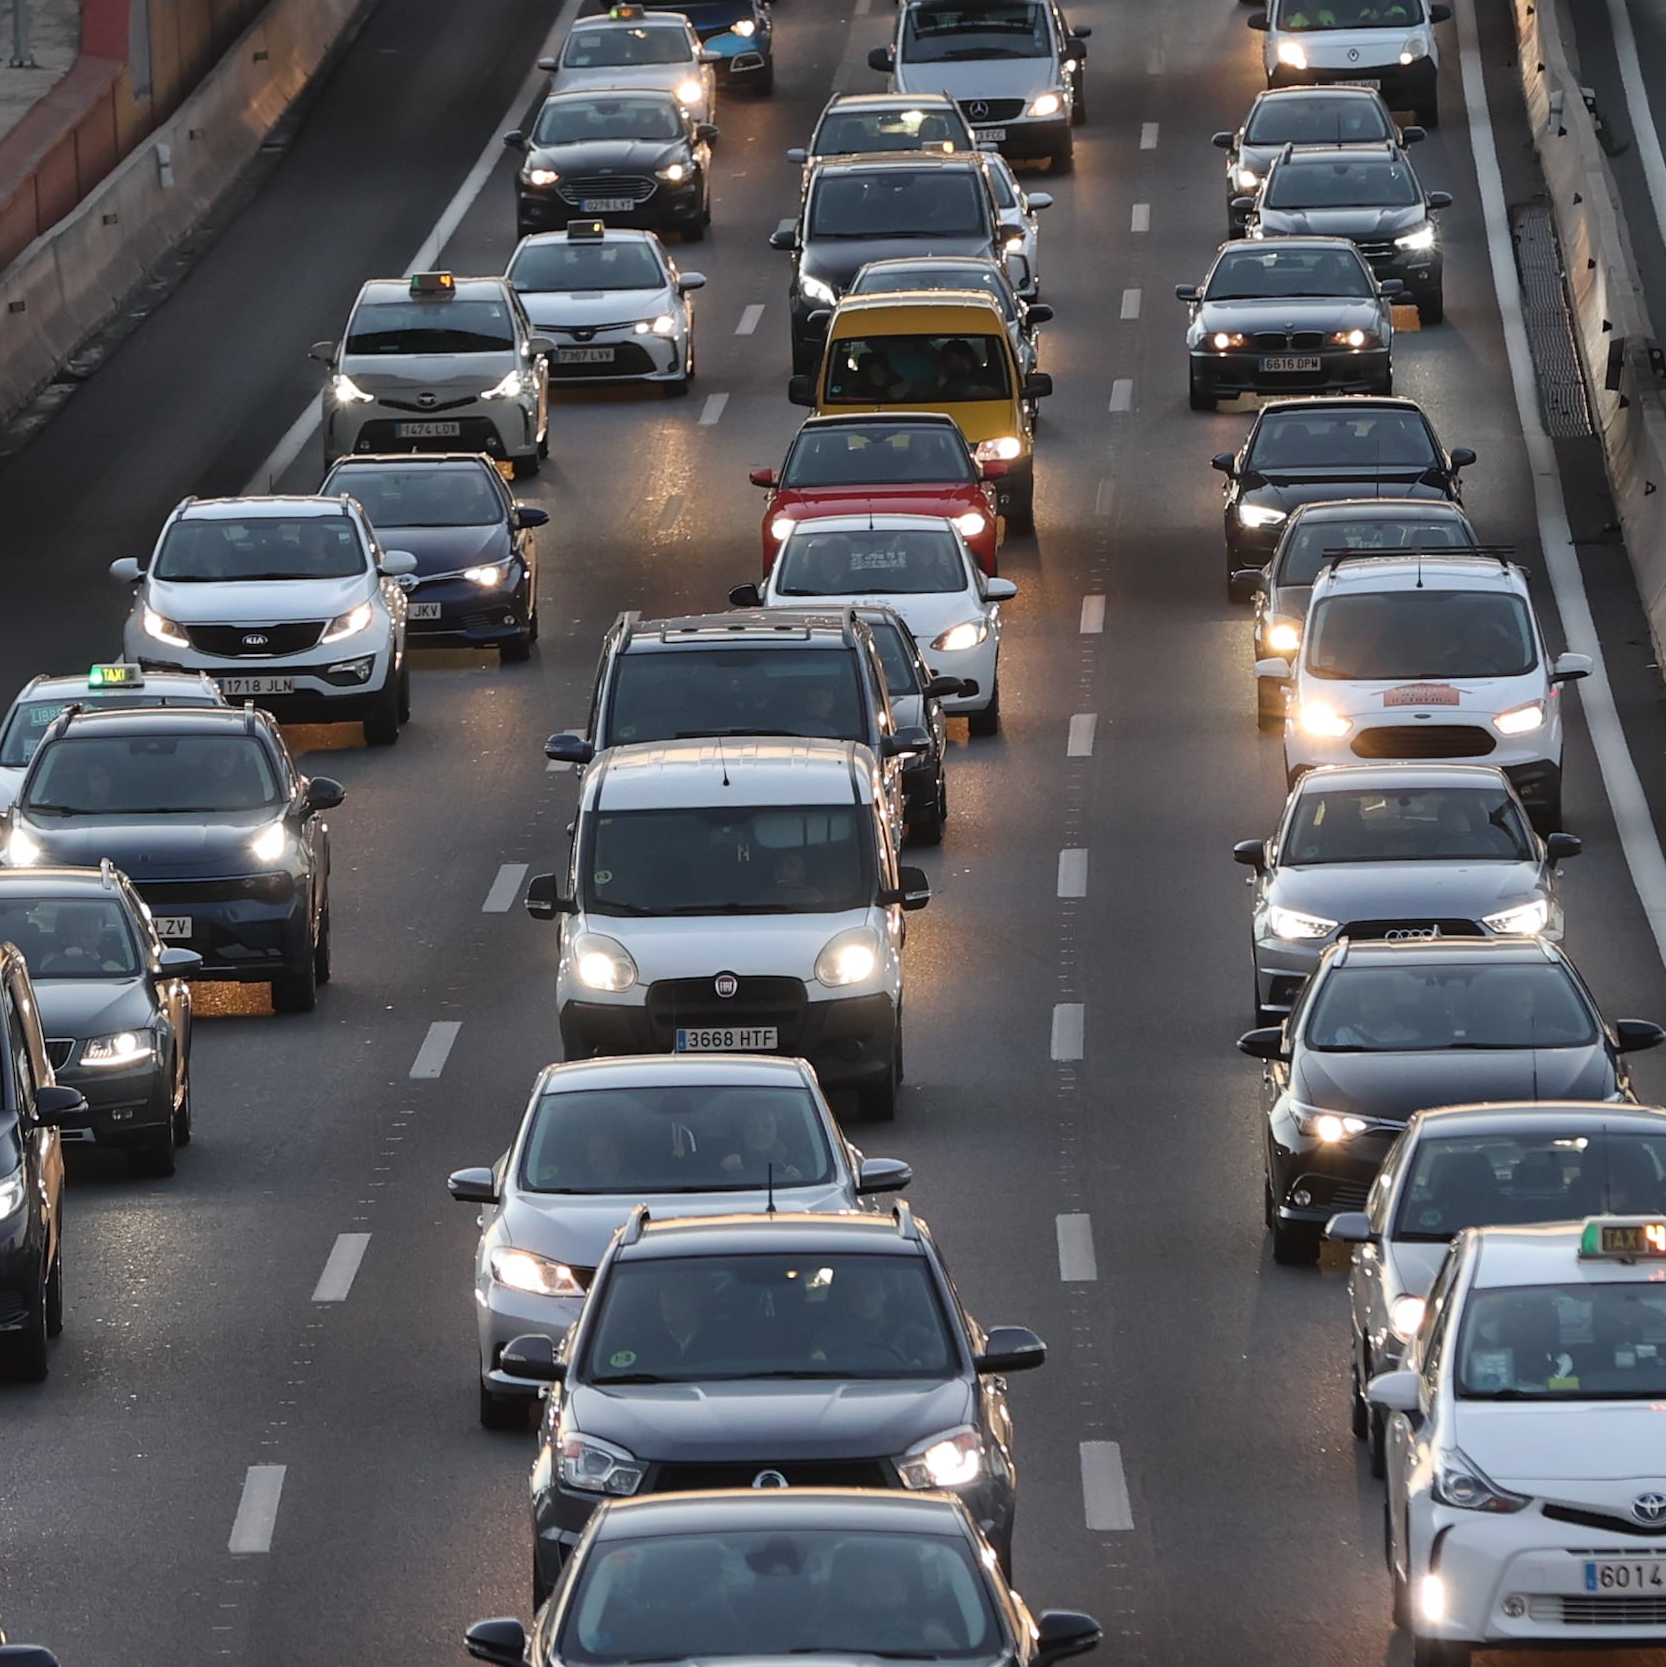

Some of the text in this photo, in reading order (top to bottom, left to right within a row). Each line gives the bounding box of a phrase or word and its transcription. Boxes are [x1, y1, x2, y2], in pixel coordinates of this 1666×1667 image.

[1266, 357, 1318, 370] 6616 DPM
[414, 605, 438, 618] JKV
[245, 636, 264, 645] KIA
[104, 668, 125, 682] TAXI
[227, 678, 293, 693] 1718 JLN
[689, 1029, 773, 1047] 3668 HTF
[1601, 1565, 1664, 1588] 6014
